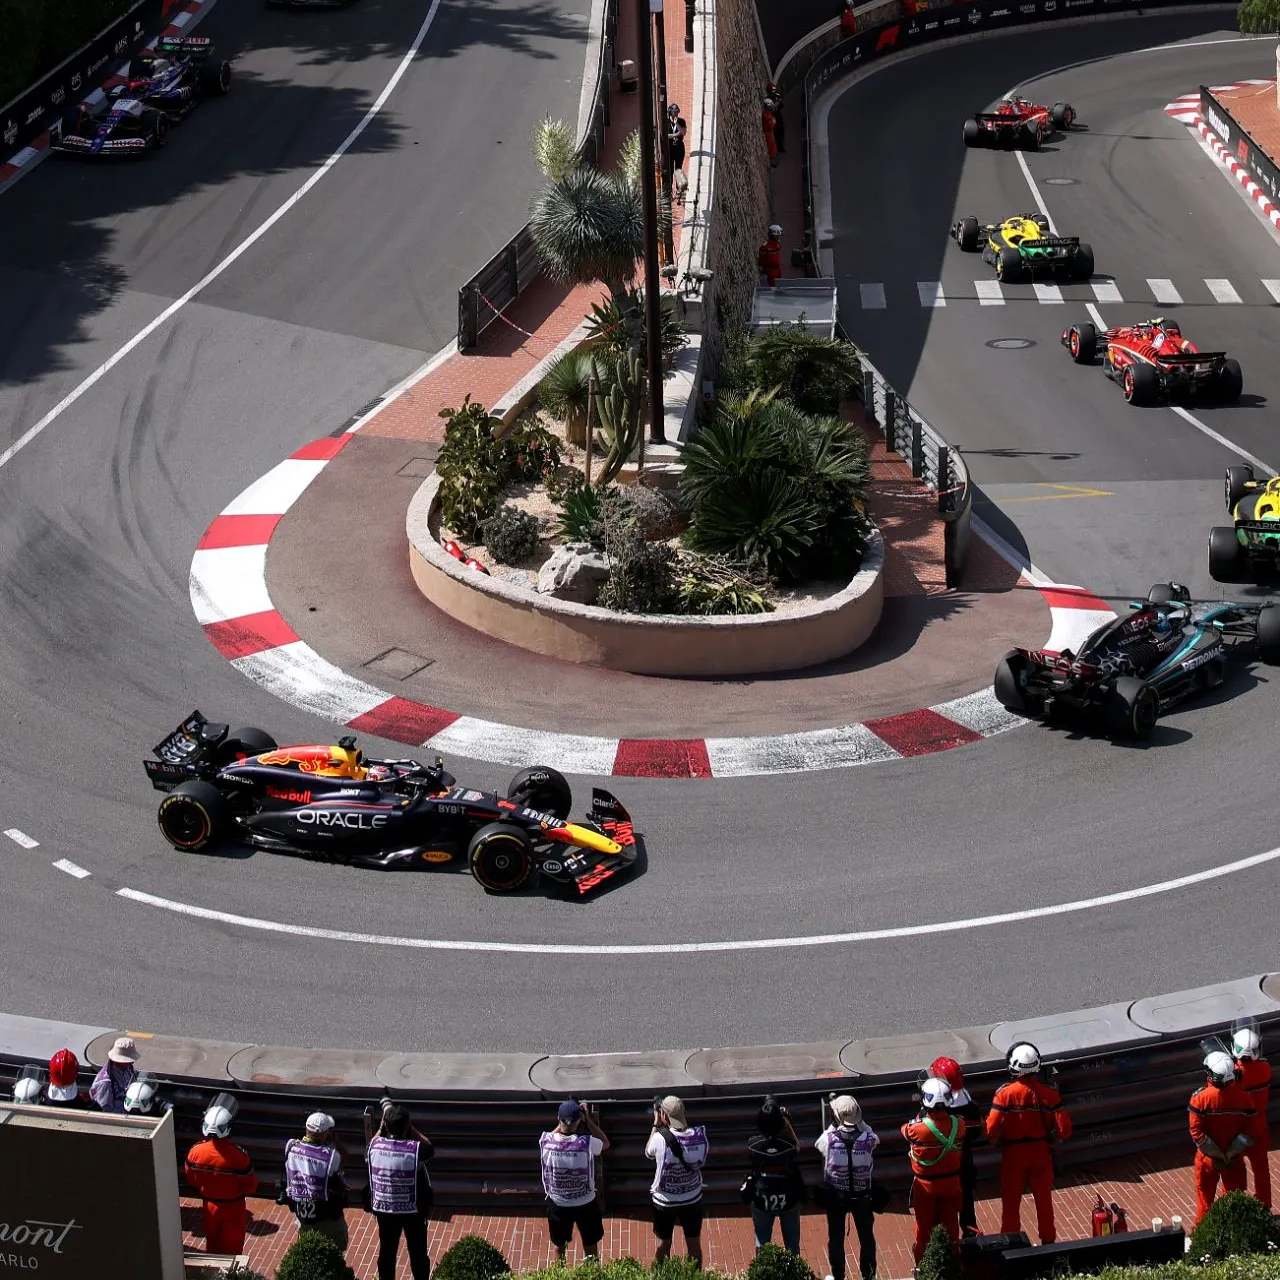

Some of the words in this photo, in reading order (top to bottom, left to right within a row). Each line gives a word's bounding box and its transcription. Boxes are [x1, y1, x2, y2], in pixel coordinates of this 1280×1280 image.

[1122, 617, 1149, 636] INEOS
[1027, 650, 1083, 674] INEOS
[1182, 645, 1224, 672] PETRONAS
[222, 773, 255, 785] HONDA
[438, 803, 466, 815] BYBIT
[593, 798, 615, 809] Claro
[297, 809, 388, 830] ORACLE
[762, 1193, 786, 1211] 127
